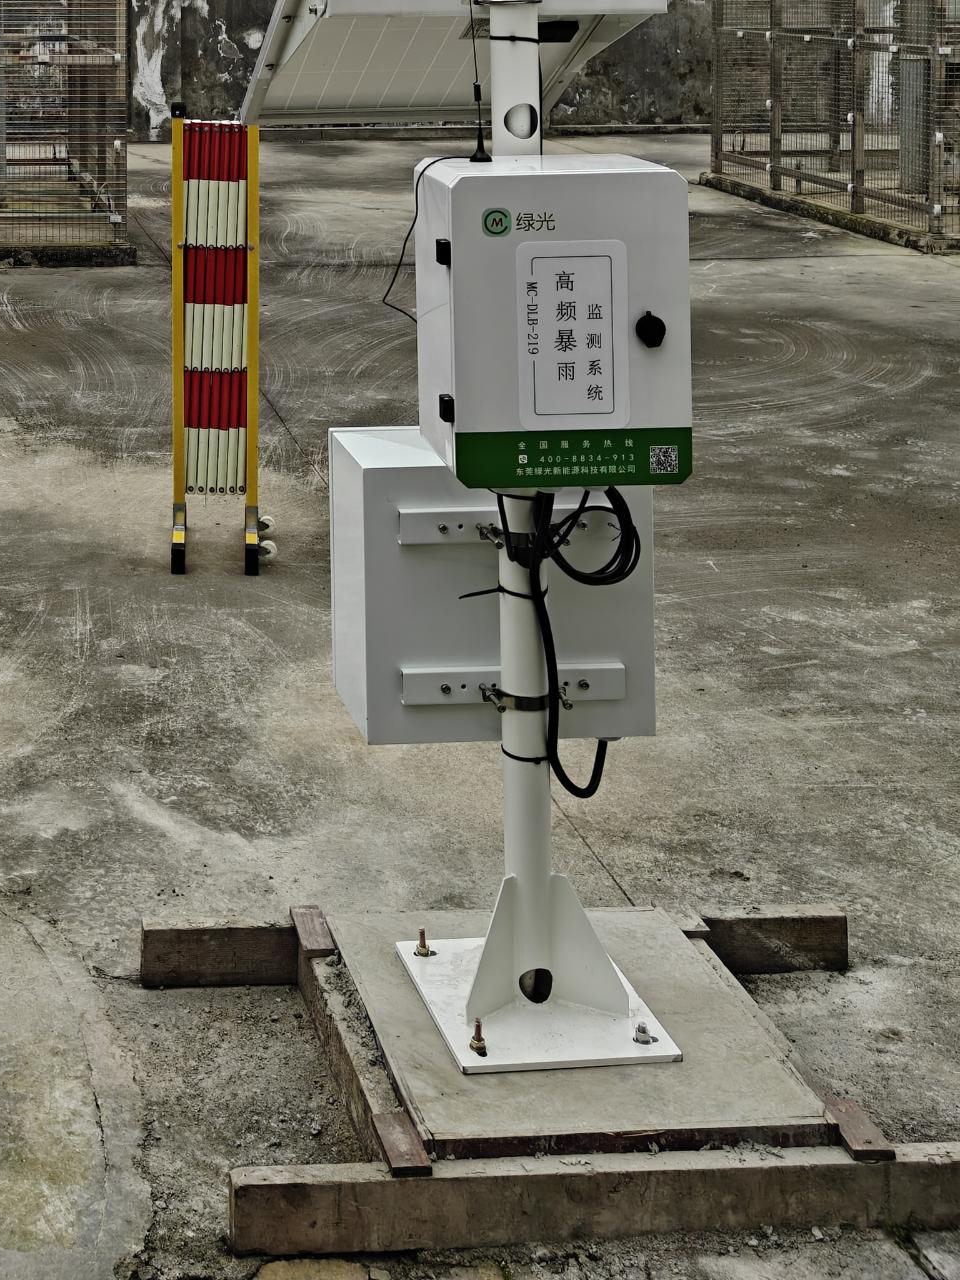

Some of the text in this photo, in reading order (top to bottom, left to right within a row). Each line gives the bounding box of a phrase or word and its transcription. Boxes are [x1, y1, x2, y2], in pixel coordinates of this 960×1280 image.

[515, 211, 556, 232] 绿光
[526, 281, 539, 355] MC-DLB-219
[554, 270, 577, 381] 高频暴雨
[586, 303, 603, 401] 监测系统
[518, 438, 634, 450] 全国服务热线
[539, 454, 634, 463] 400-8834-913
[516, 464, 636, 477] 东莞绿光新能源科技有限公司
